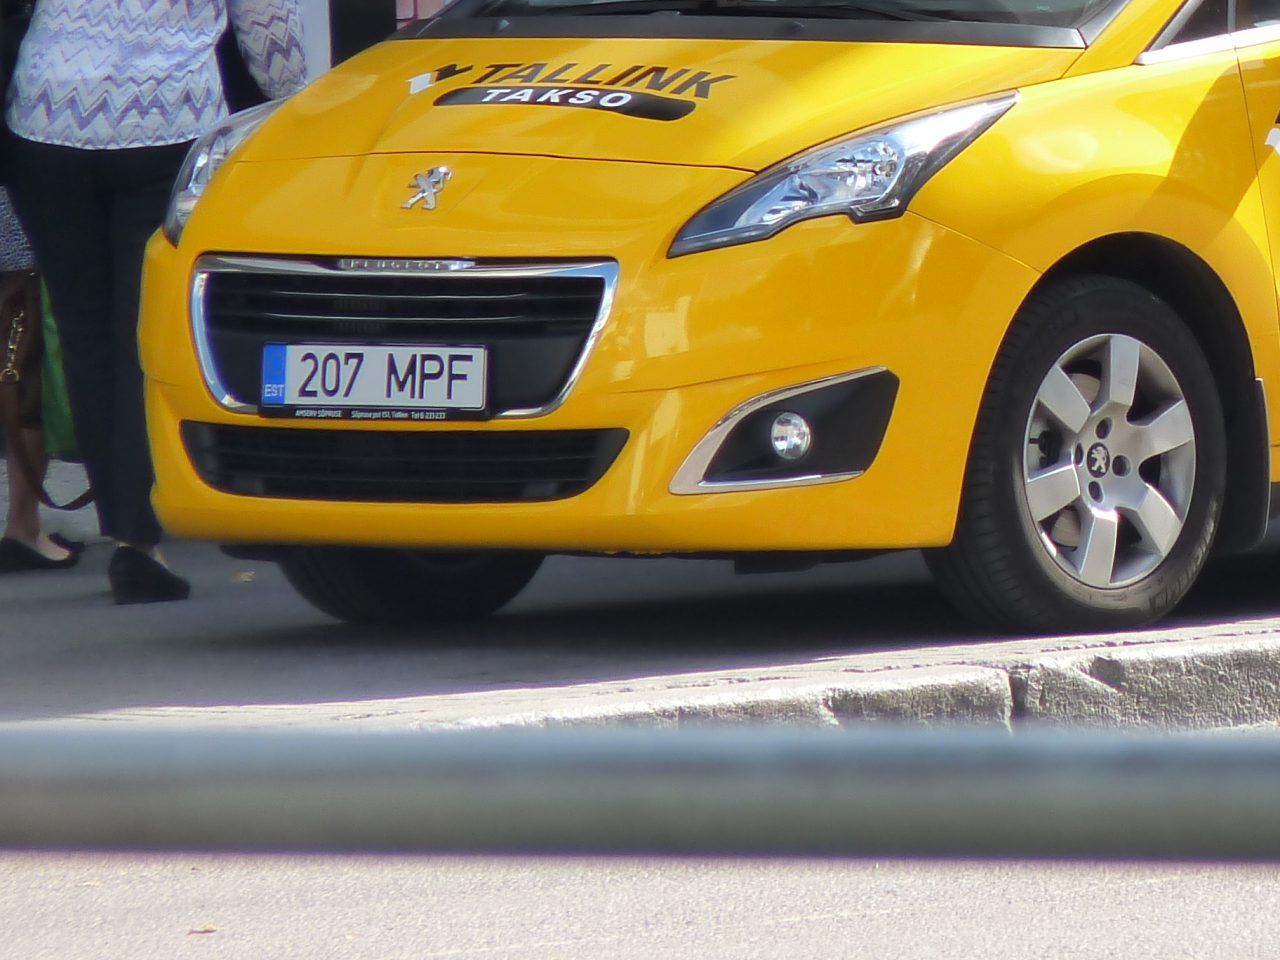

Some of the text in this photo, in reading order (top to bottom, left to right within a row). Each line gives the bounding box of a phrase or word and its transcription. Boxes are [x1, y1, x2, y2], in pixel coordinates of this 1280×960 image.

[470, 62, 737, 99] TALLINK
[481, 89, 632, 107] TAKSO
[298, 352, 474, 400] 207 MPF
[264, 384, 285, 397] EST
